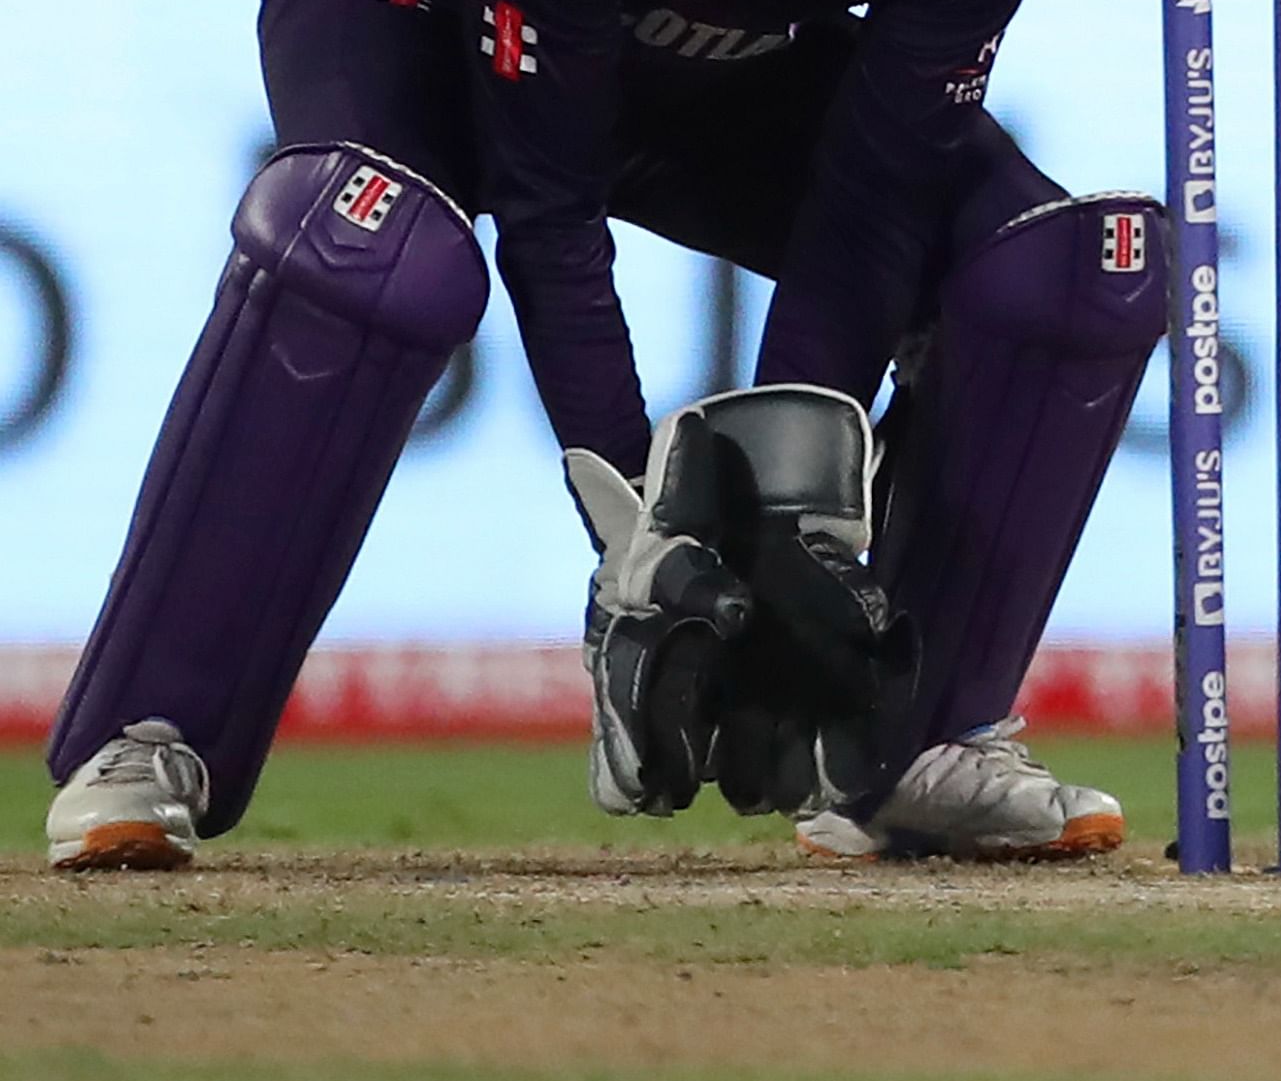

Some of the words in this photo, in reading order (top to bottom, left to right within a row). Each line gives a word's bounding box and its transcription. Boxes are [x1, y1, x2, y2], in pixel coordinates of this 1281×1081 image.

[1186, 48, 1214, 175] BYJU'S
[1186, 265, 1223, 414] postpe
[1195, 450, 1222, 576] BYJU'S
[1197, 671, 1228, 819] postpe
